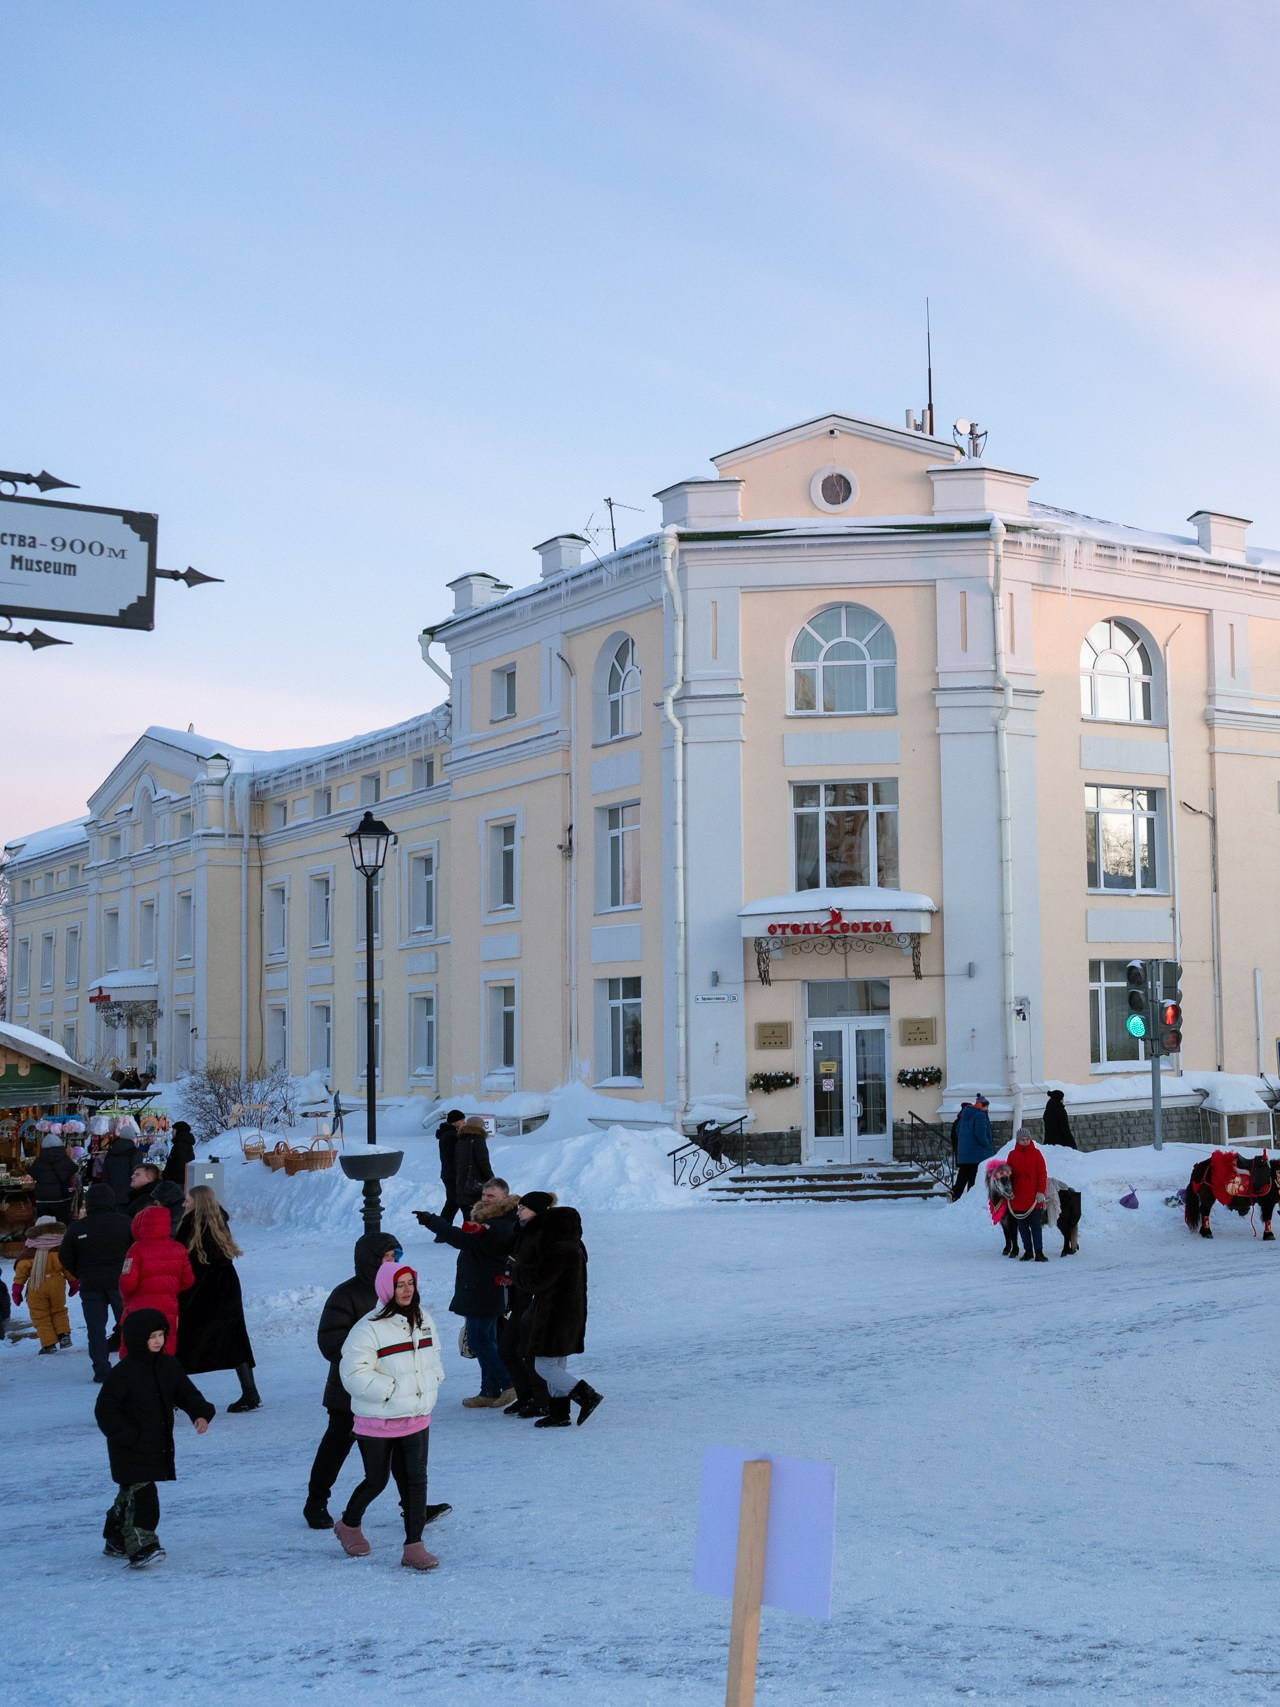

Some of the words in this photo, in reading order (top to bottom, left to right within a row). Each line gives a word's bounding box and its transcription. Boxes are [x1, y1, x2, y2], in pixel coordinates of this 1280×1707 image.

[10, 554, 77, 576] Museum
[767, 923, 823, 935] ОТЕЛЬ
[840, 921, 893, 933] СОКОЛ
